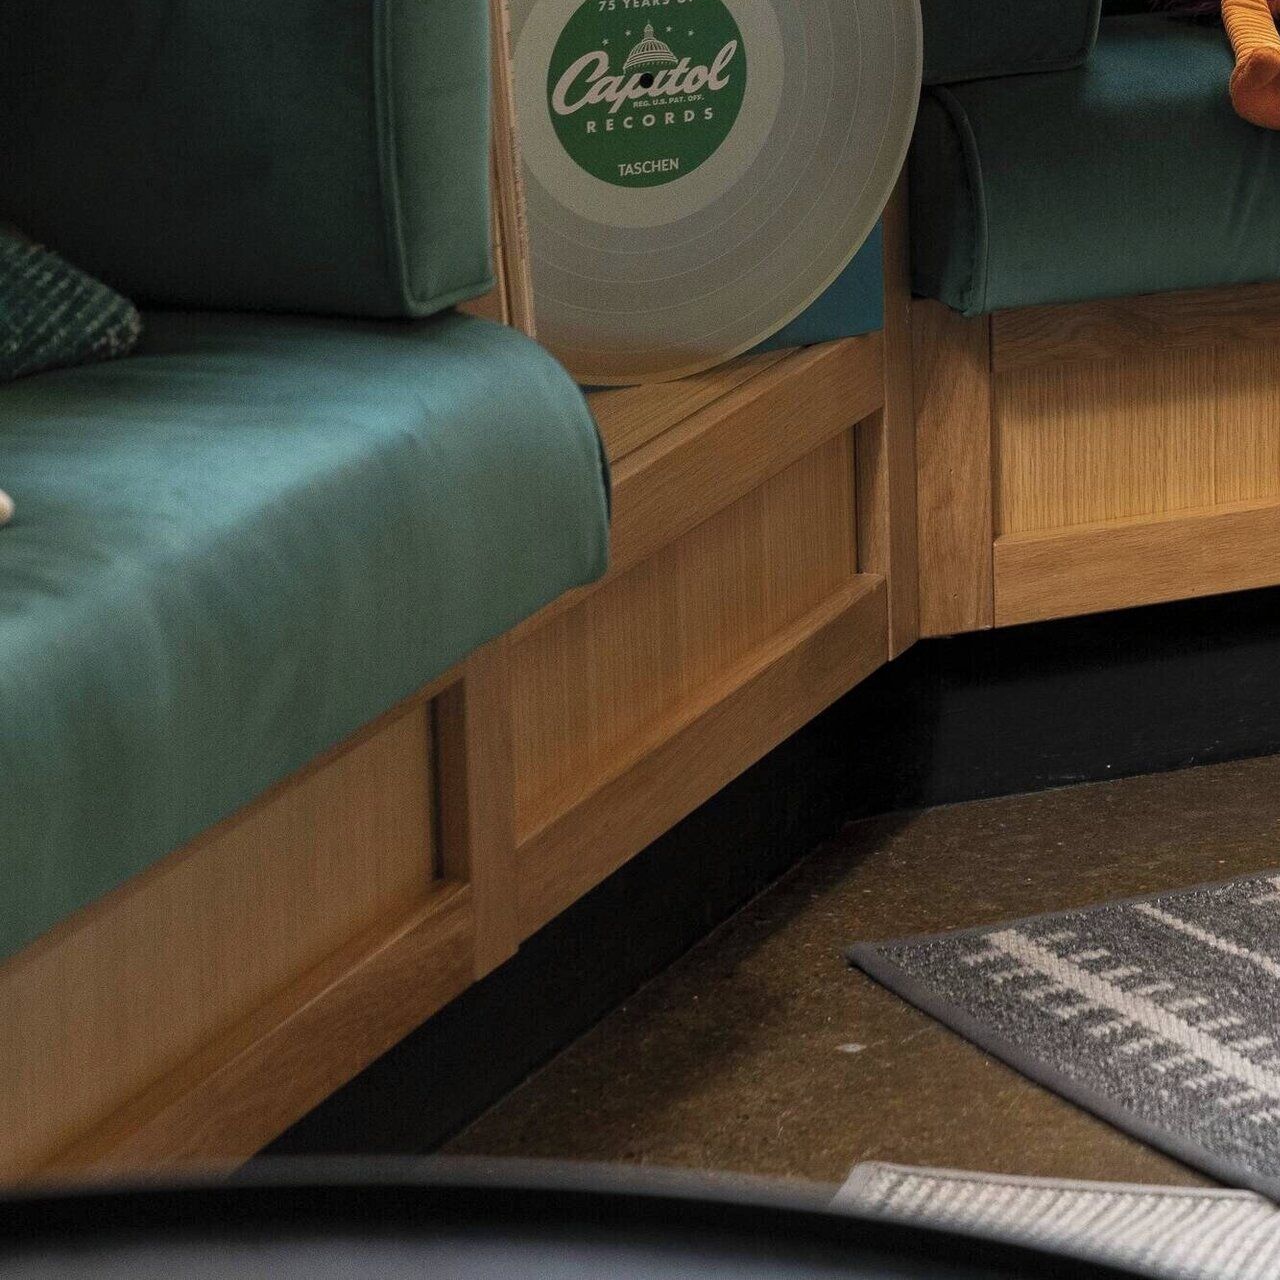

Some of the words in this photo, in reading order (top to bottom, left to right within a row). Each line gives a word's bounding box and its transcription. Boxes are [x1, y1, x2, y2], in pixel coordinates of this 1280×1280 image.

[598, 0, 616, 12] 75
[552, 39, 738, 115] Capitol
[633, 100, 651, 108] REG.
[652, 98, 667, 106] U.S.
[668, 96, 686, 104] PAT.
[586, 107, 713, 134] RECORDS
[617, 157, 679, 176] TASCHEN
